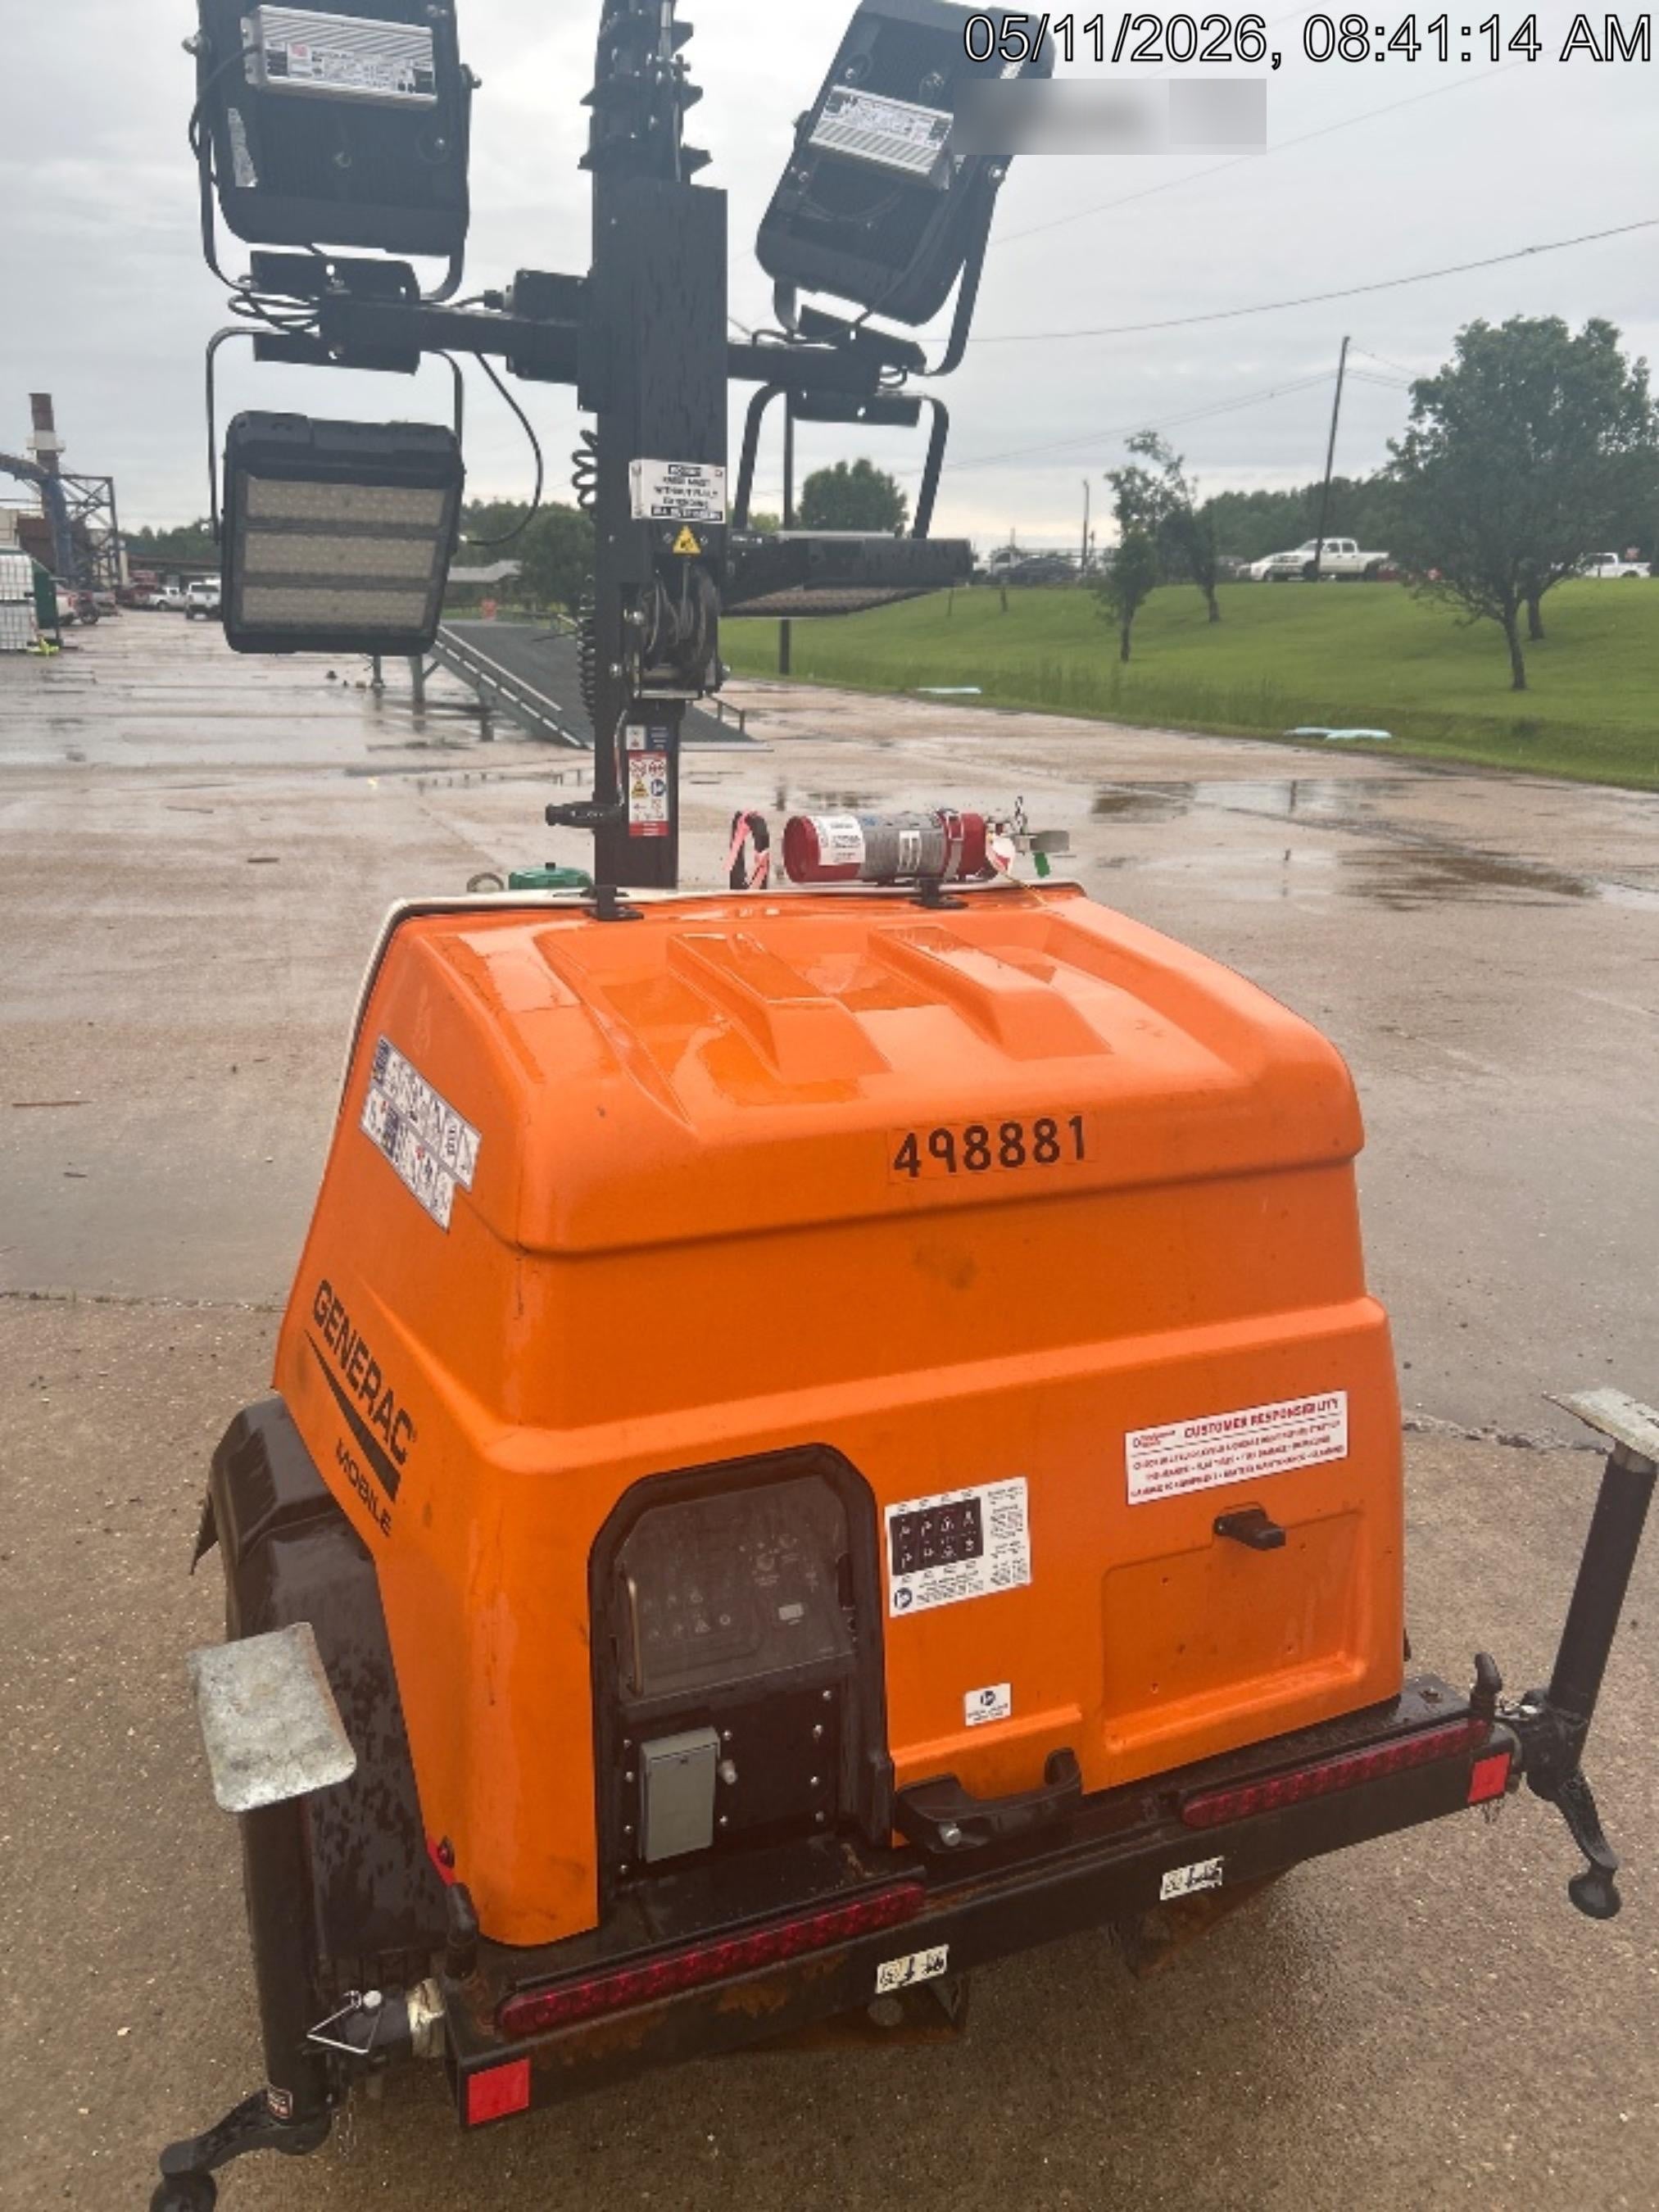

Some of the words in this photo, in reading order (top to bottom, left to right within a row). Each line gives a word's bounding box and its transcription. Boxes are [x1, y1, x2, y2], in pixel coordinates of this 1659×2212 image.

[893, 1115, 1085, 1178] 498881
[313, 1279, 414, 1466] GENERAC
[1184, 1417, 1248, 1439] CUSTOMER
[1250, 1398, 1339, 1426] RESPONSIBILITY
[336, 1437, 392, 1538] MOBILE
